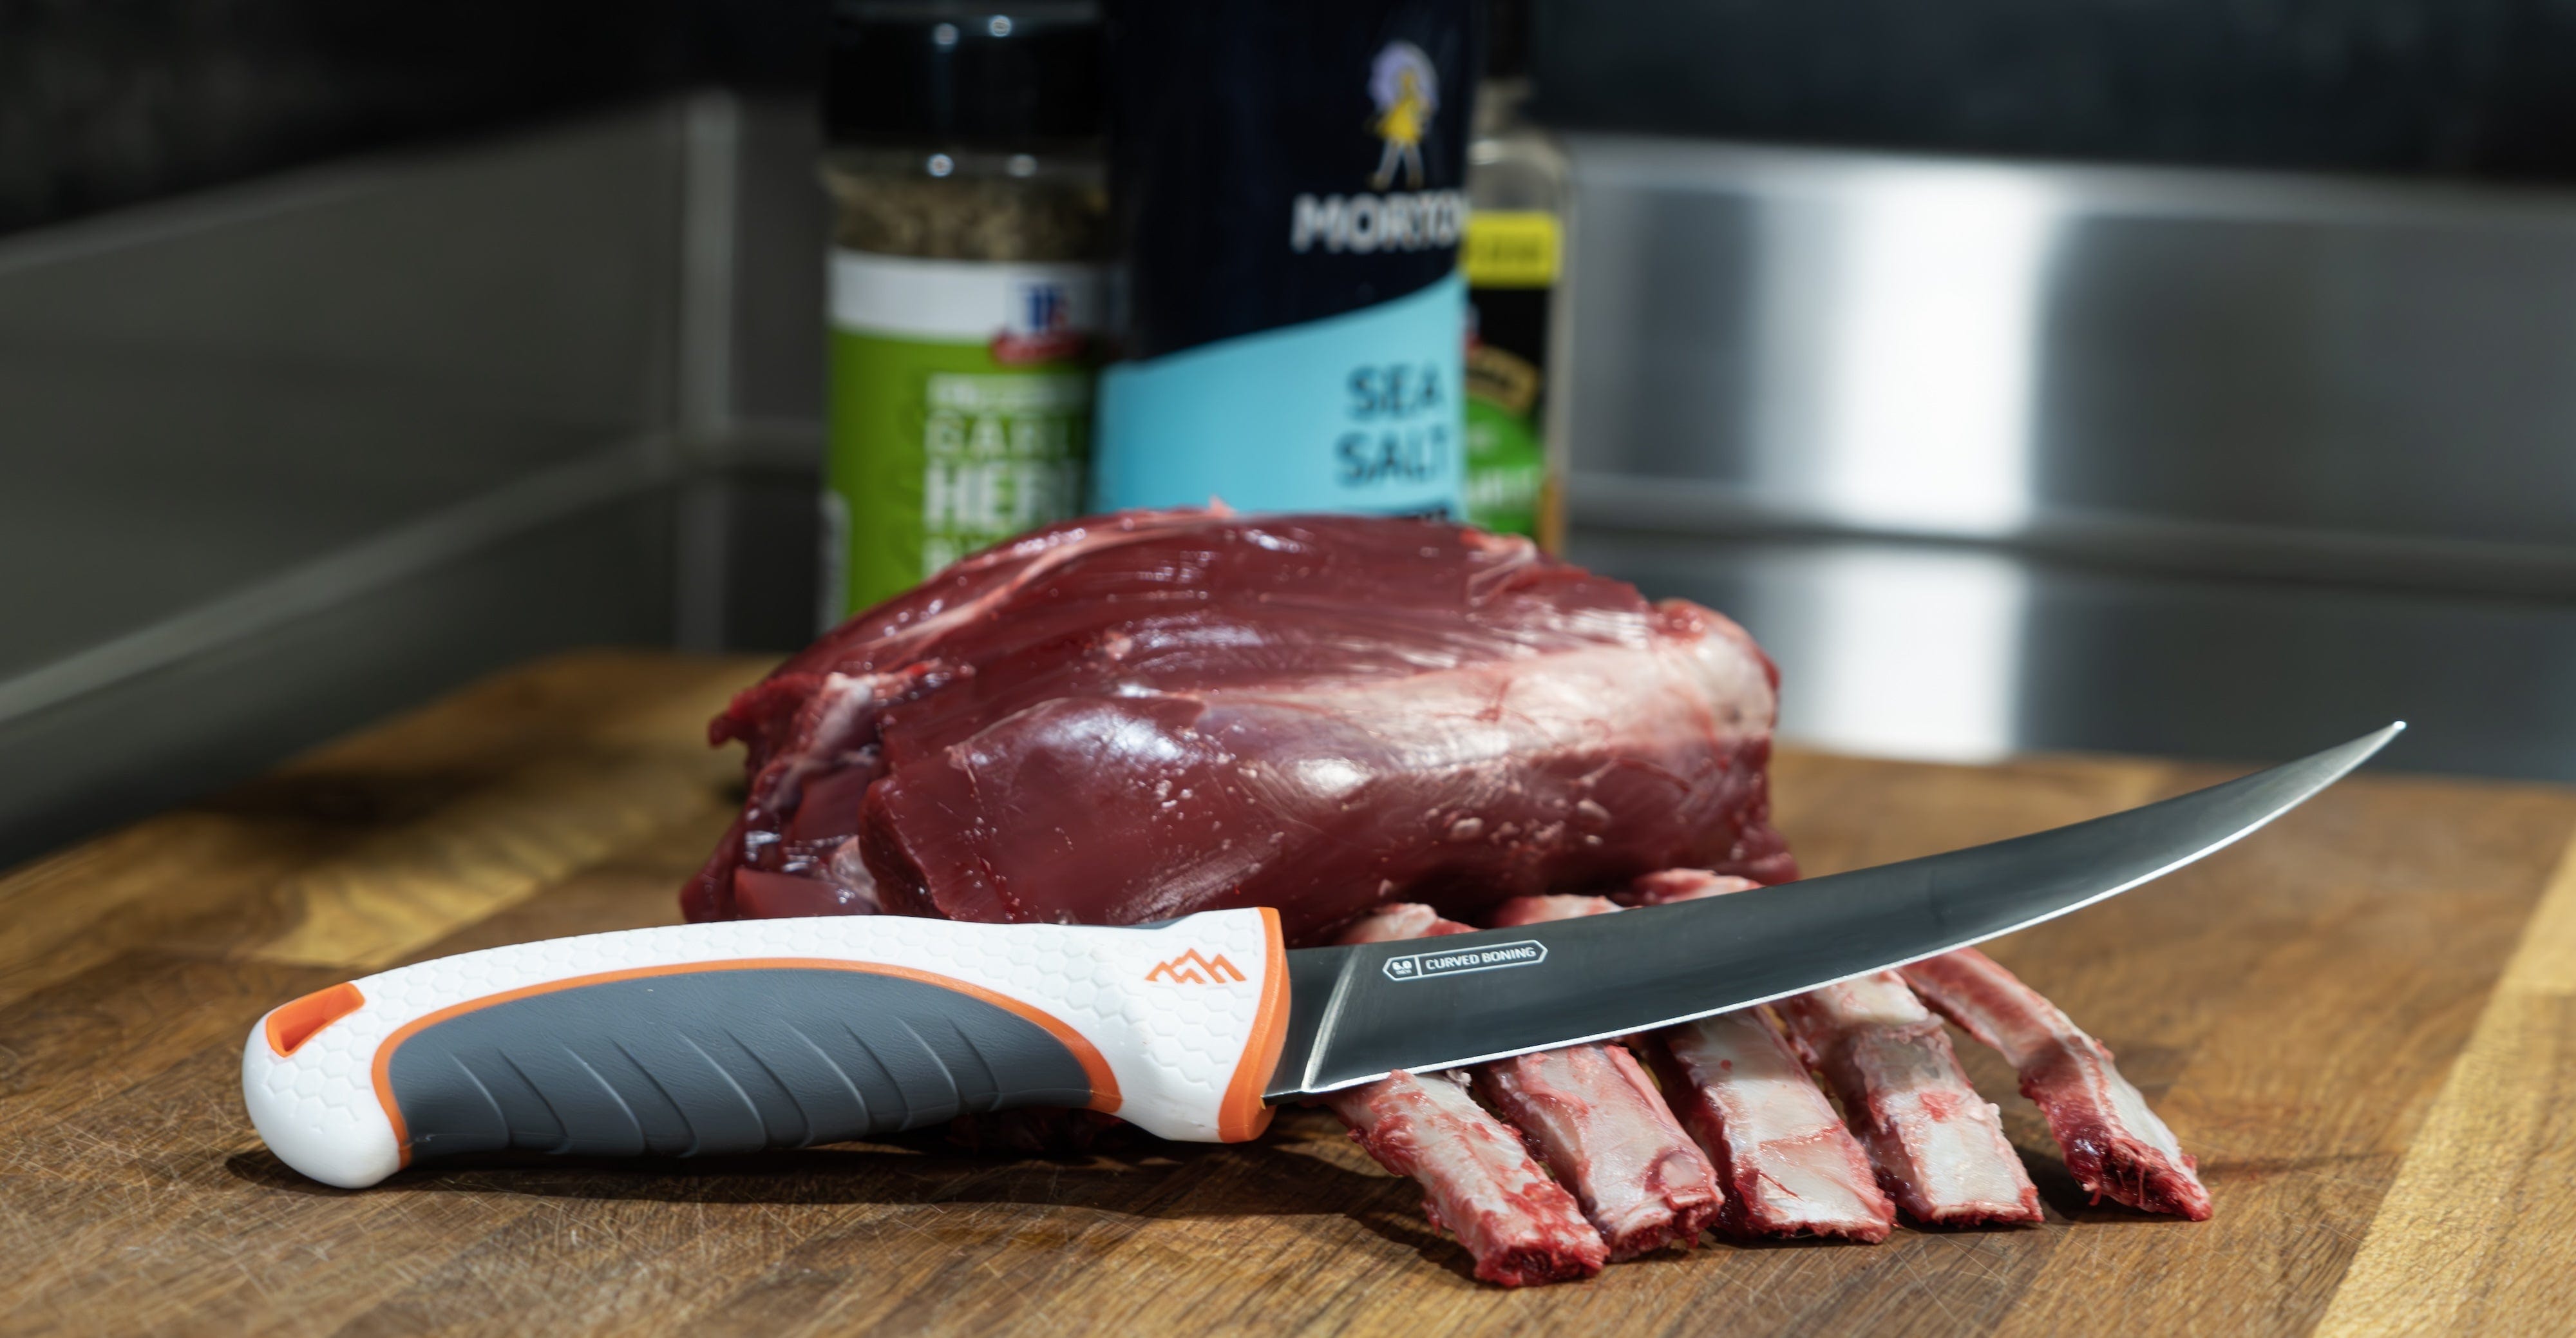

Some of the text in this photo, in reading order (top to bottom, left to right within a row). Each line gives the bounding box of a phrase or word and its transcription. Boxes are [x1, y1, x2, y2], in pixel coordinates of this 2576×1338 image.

[1290, 191, 1464, 254] MORTO
[1347, 363, 1446, 421] SEA
[1335, 423, 1448, 488] SALT
[1425, 946, 1537, 970] CURVED BONING
